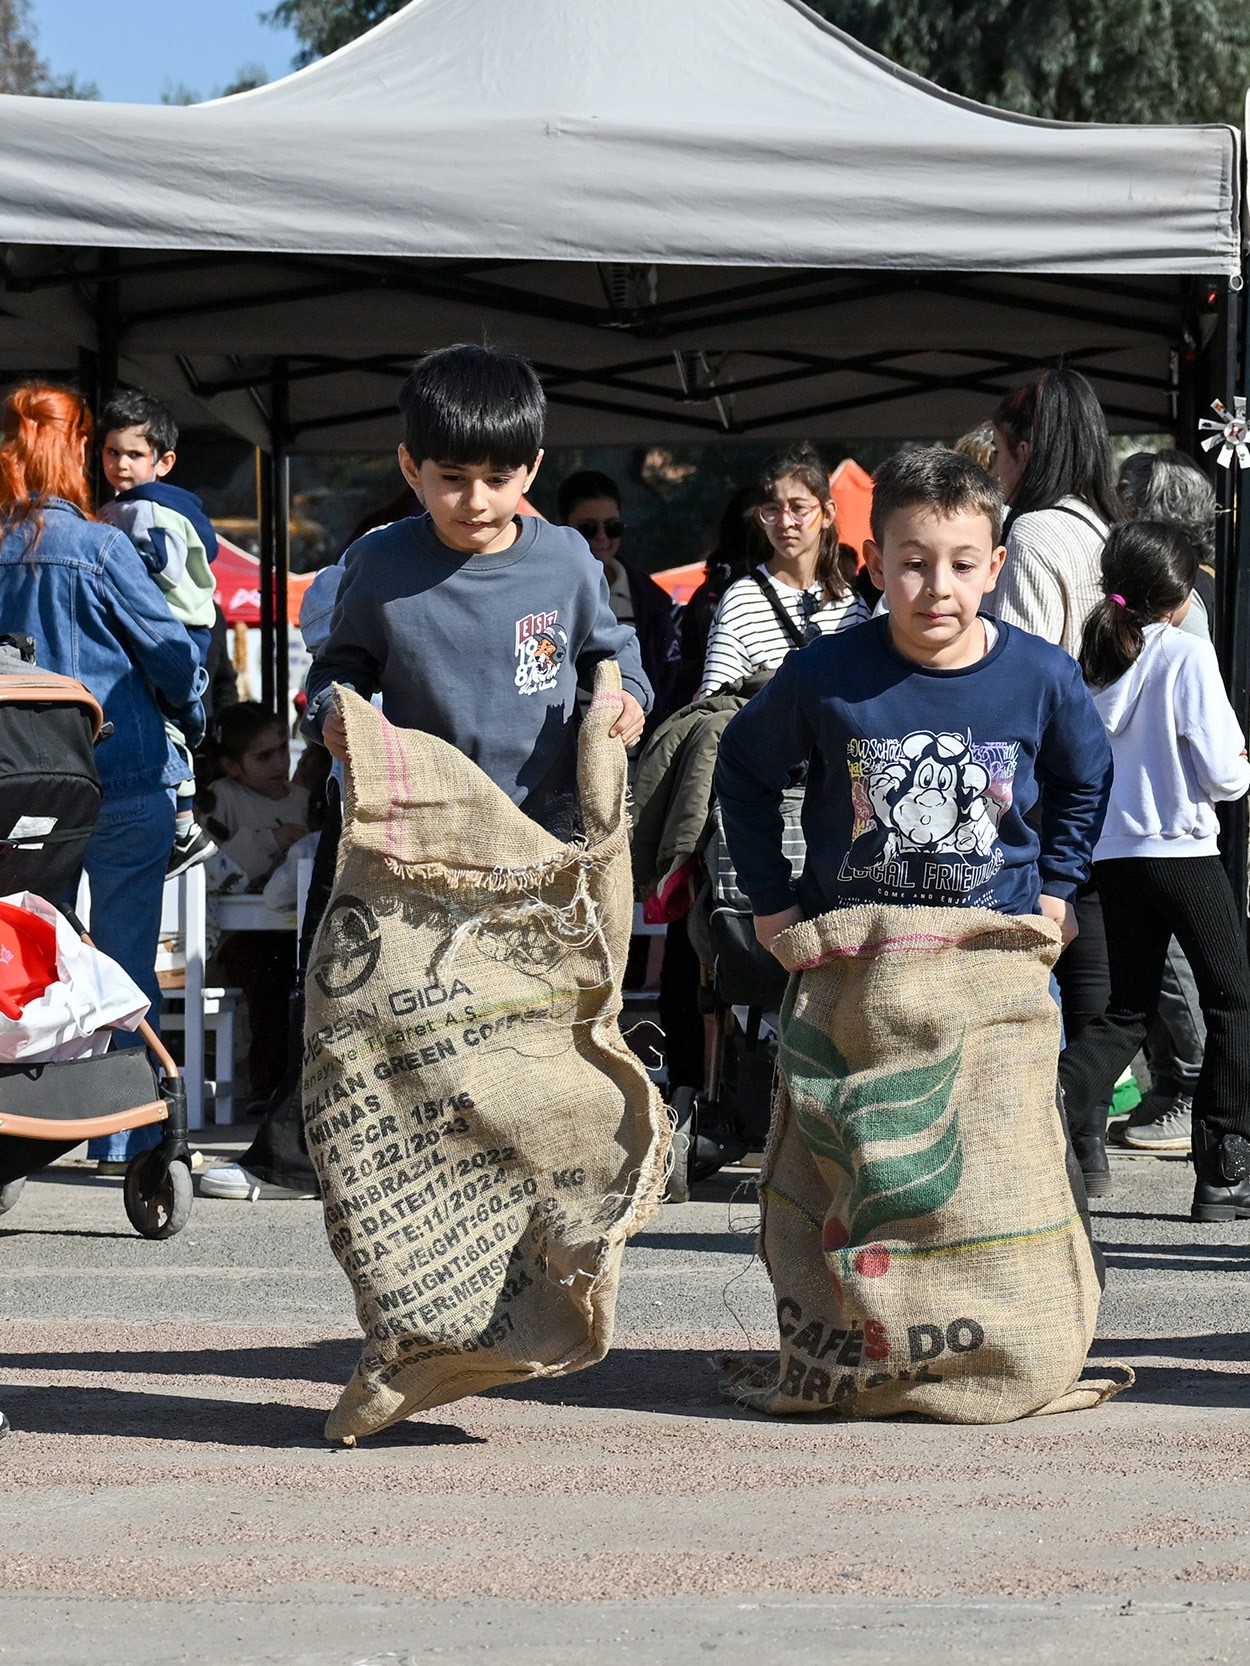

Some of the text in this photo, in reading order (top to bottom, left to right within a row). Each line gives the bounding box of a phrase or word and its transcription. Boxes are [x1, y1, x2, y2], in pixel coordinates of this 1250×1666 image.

[877, 887, 905, 899] COME
[940, 894, 972, 904] ENJOY
[388, 978, 474, 1016] GIDA
[373, 1037, 458, 1081] GREEN
[308, 1094, 381, 1147] MINAS
[350, 1091, 475, 1152] SCR 15/16
[341, 1117, 470, 1188] 2022/2023
[908, 1317, 985, 1363] DO
